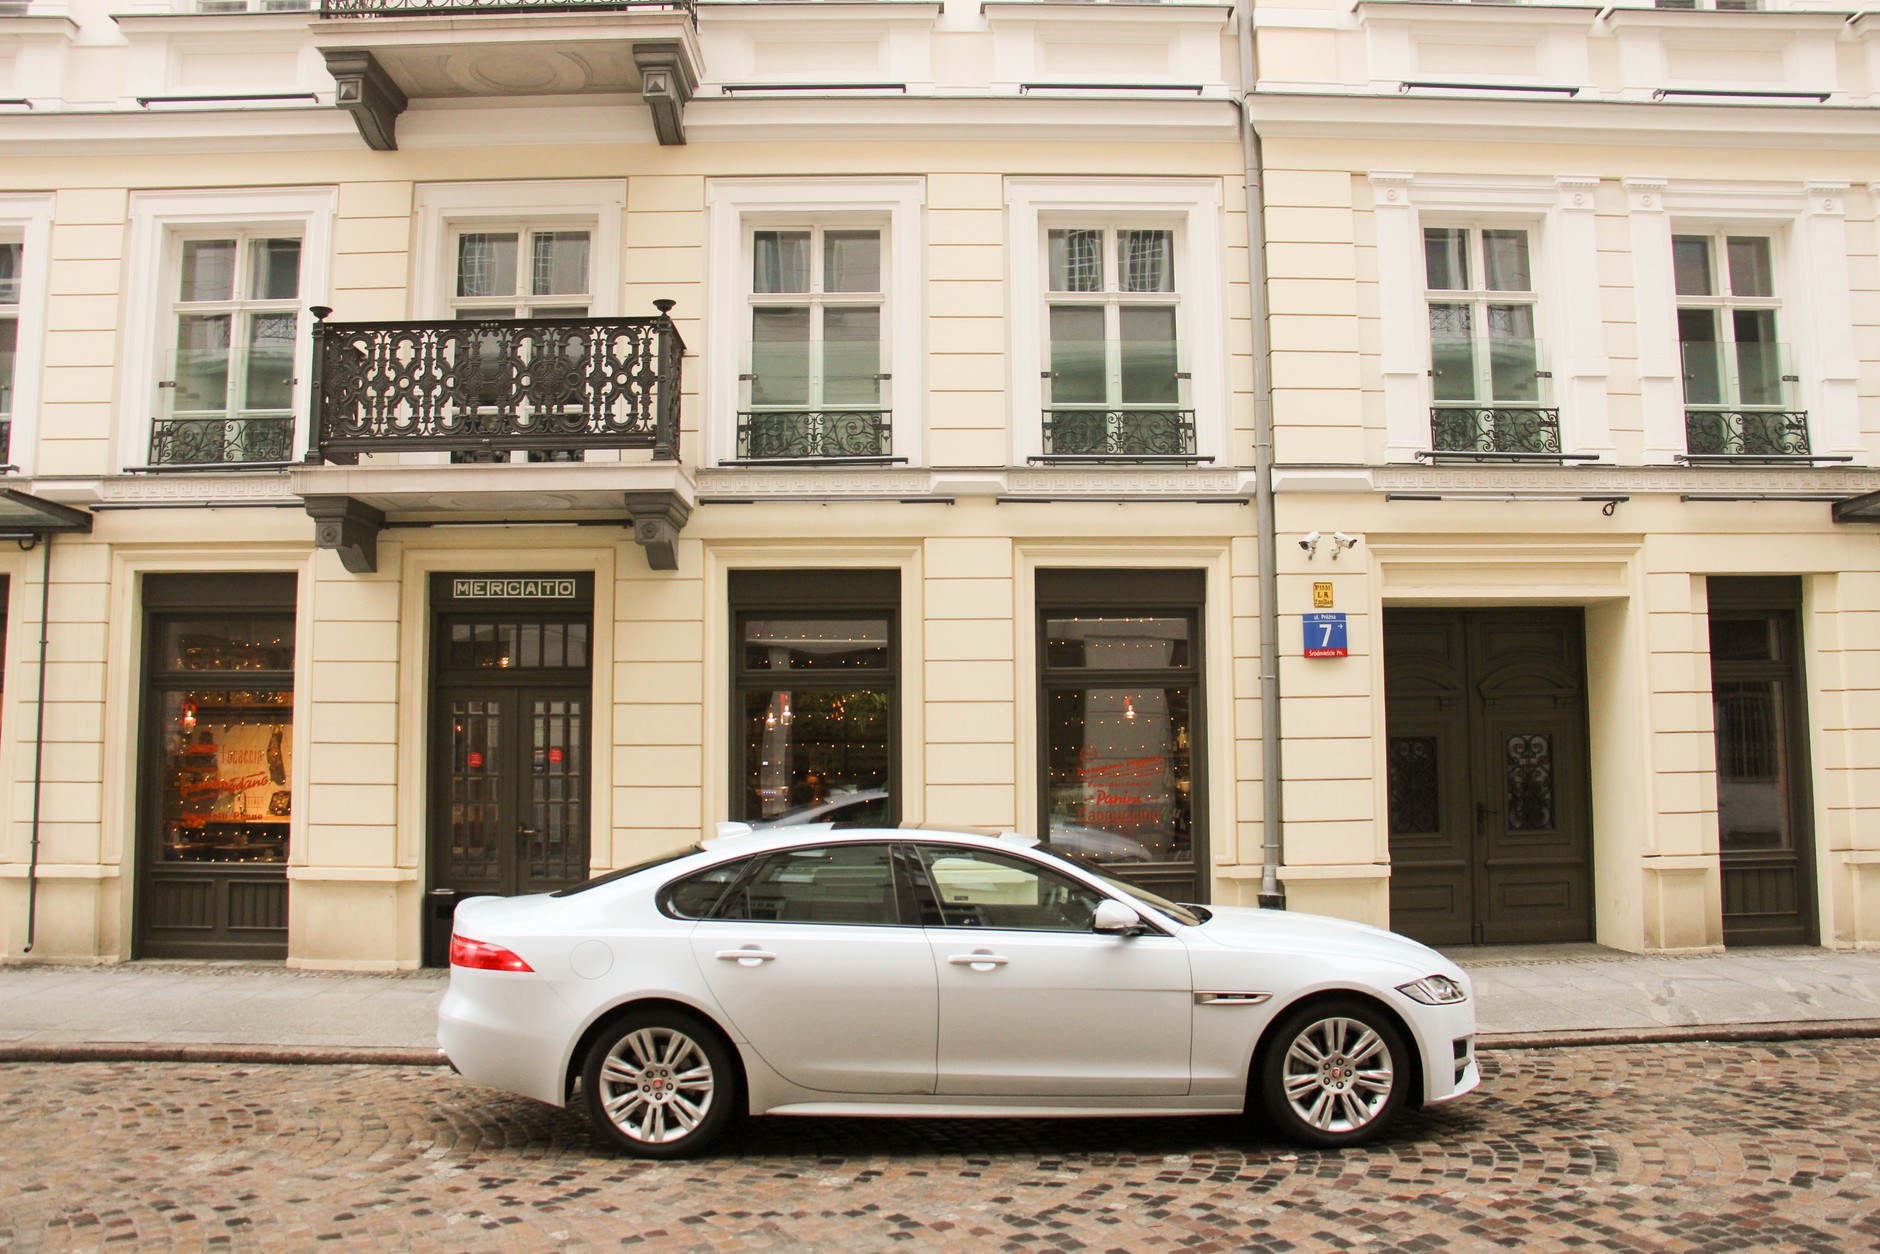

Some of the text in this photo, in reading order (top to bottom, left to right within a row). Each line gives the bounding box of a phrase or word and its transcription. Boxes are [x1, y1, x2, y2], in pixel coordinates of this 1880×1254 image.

[456, 582, 572, 595] MERCATO
[1319, 624, 1332, 647] 7
[1096, 789, 1143, 806] Panini
